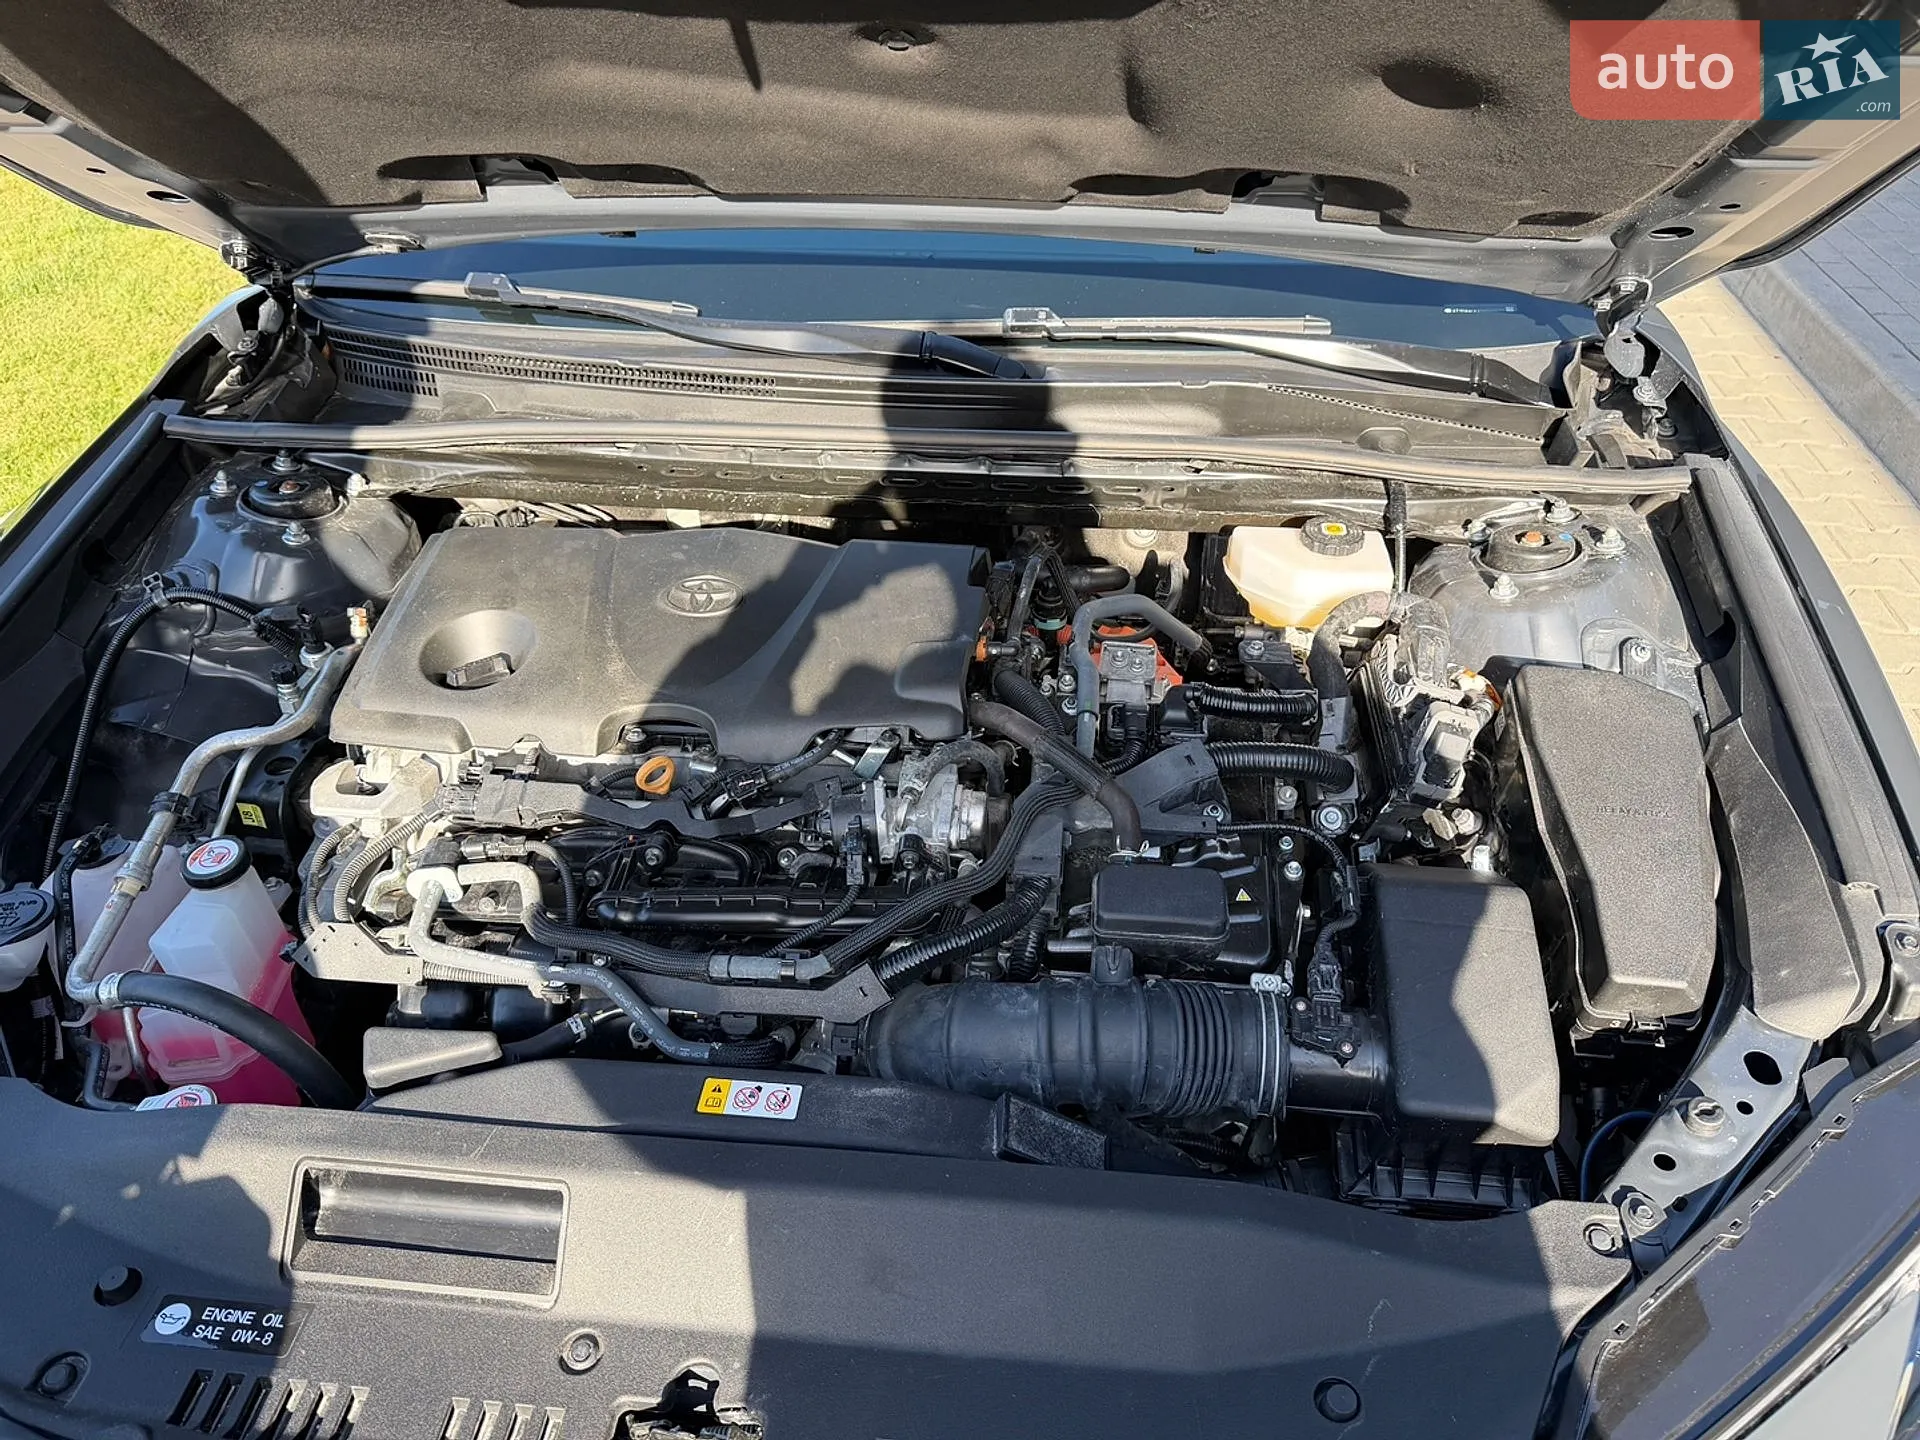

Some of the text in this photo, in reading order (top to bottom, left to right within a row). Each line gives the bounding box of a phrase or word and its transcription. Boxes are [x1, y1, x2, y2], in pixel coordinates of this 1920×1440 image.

[201, 1306, 284, 1328] ENGINE OIL
[192, 1325, 274, 1346] SAE 0W-8
